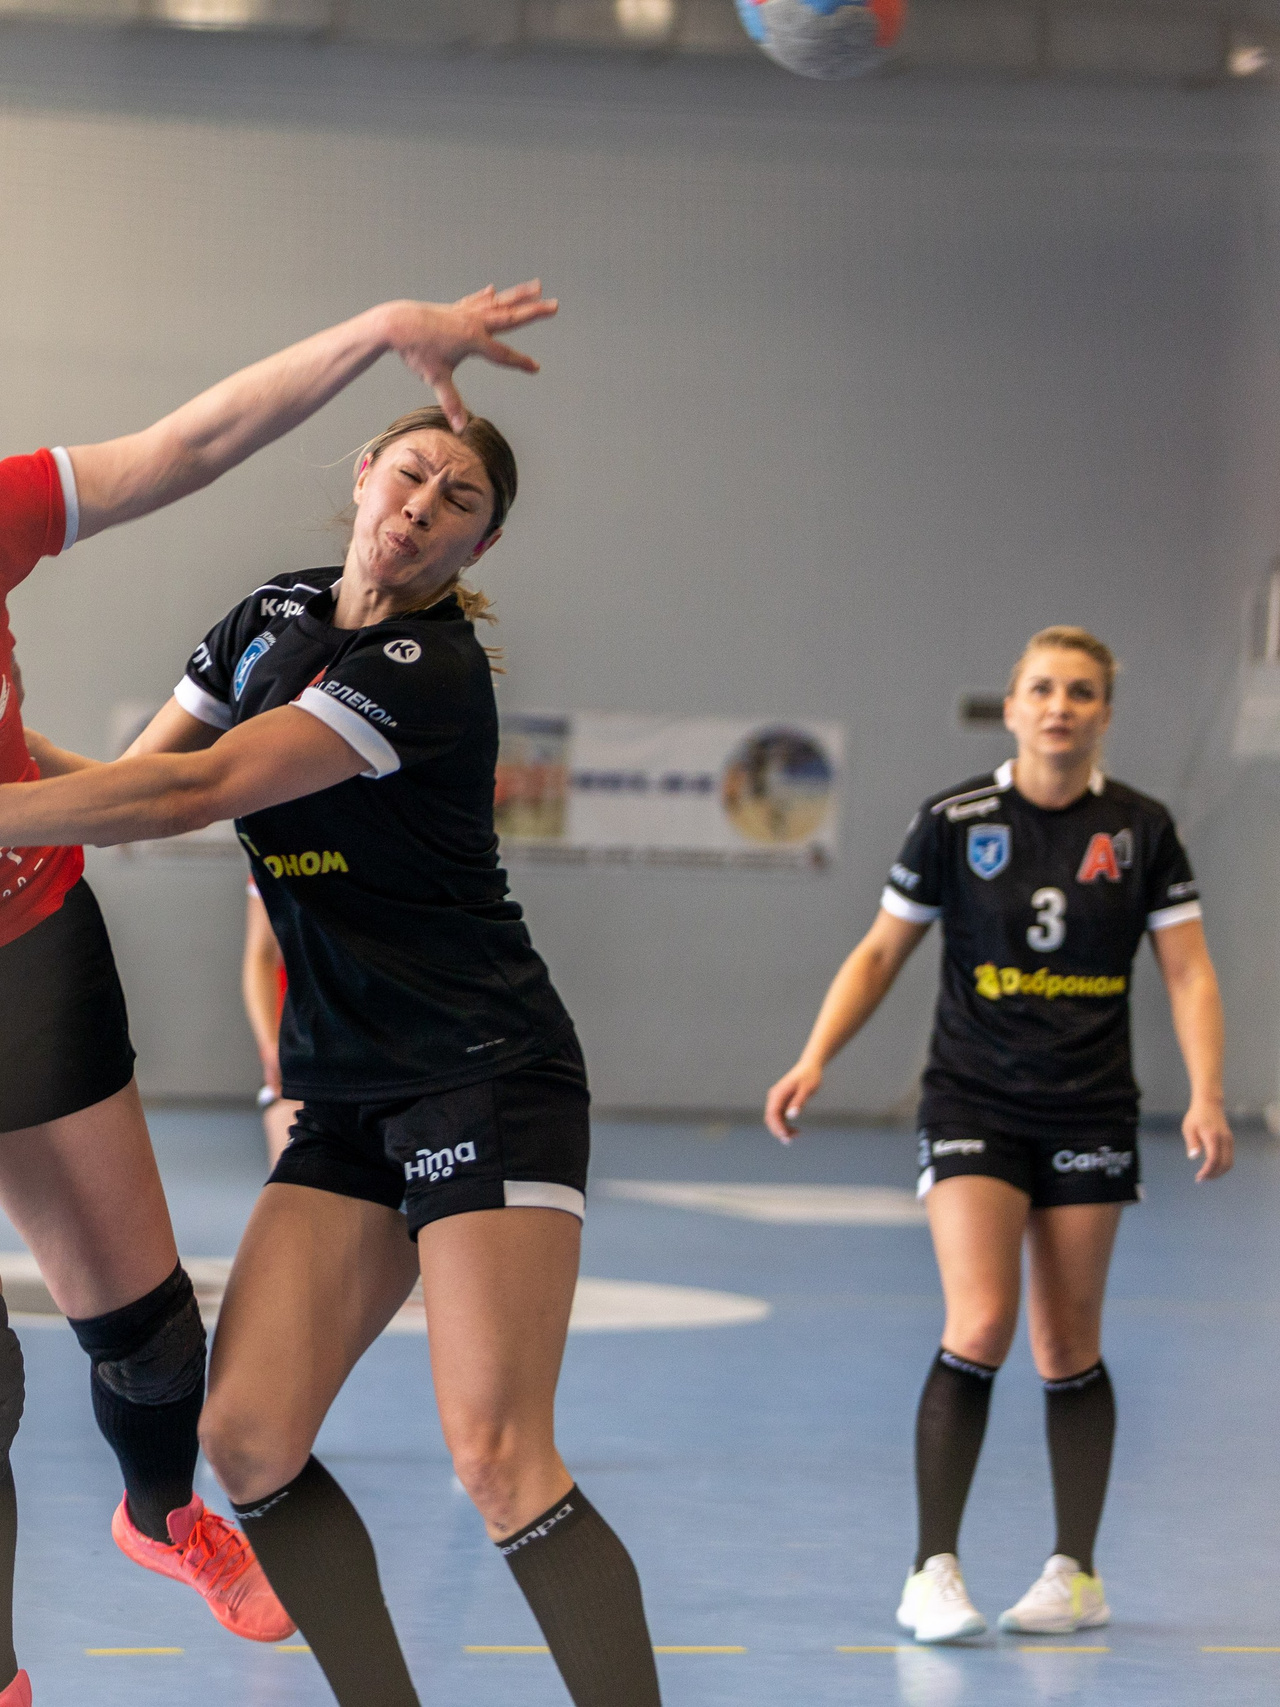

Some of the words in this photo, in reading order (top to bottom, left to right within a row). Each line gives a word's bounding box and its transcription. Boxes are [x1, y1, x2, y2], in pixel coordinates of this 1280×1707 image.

[316, 680, 398, 728] ЕЛЕКОМ
[1027, 886, 1067, 952] 3
[500, 1503, 574, 1556] empa
